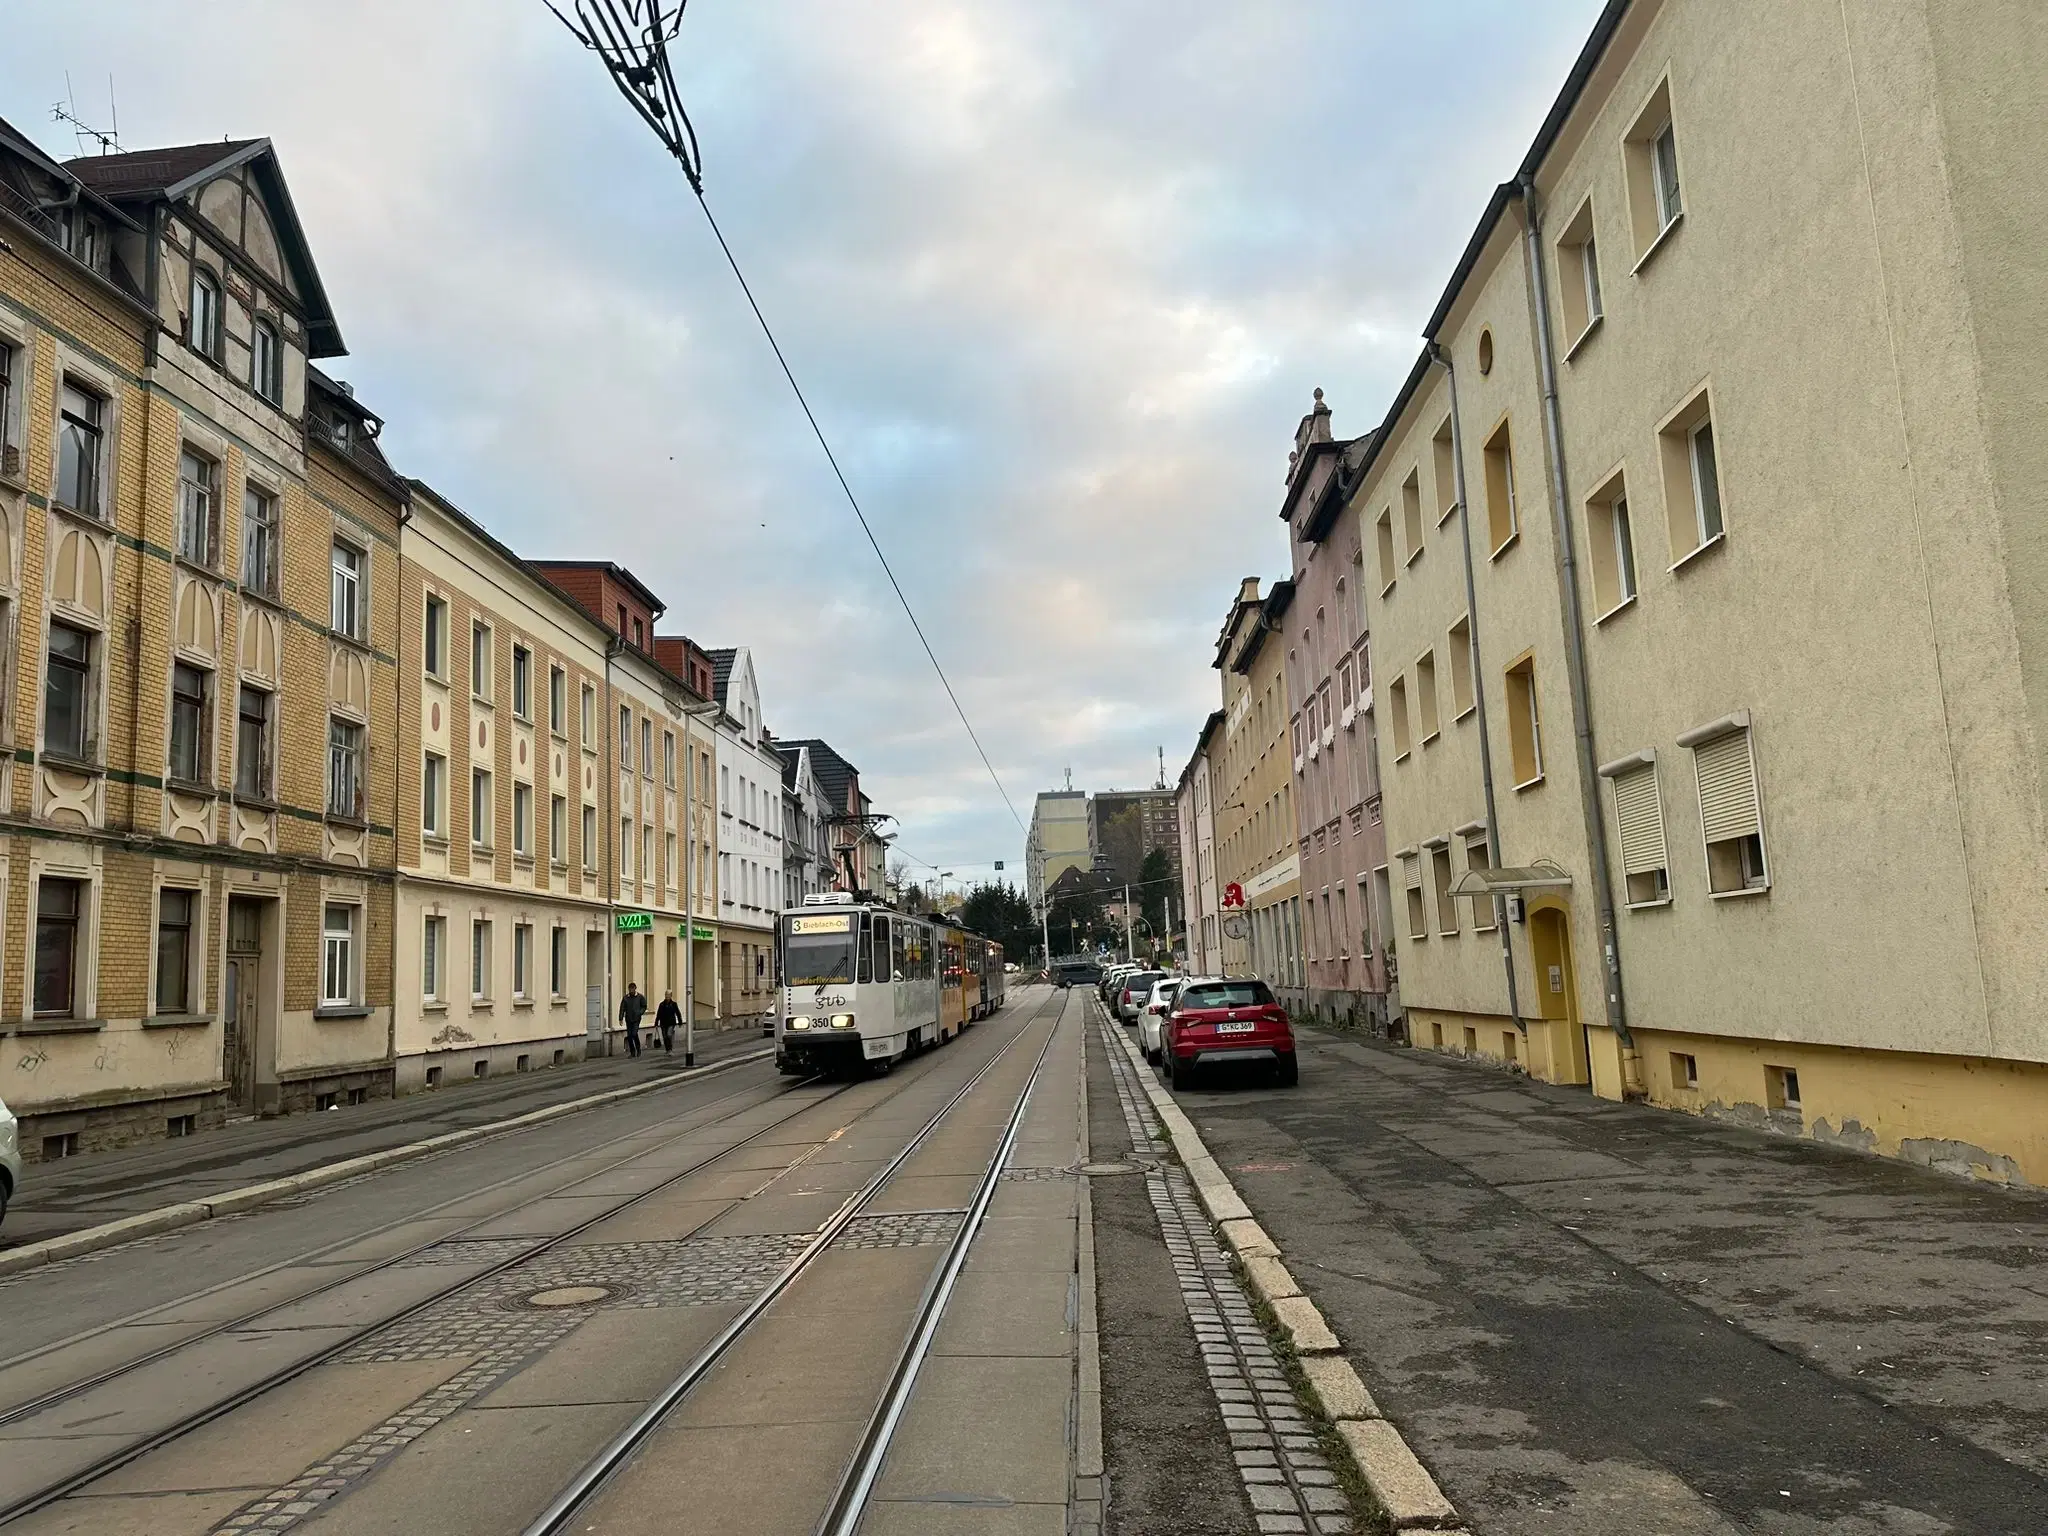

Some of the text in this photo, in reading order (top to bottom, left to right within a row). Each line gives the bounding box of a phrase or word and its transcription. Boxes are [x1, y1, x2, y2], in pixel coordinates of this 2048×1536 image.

[617, 914, 640, 927] LVM
[793, 920, 802, 931] 3
[812, 1017, 829, 1028] 350
